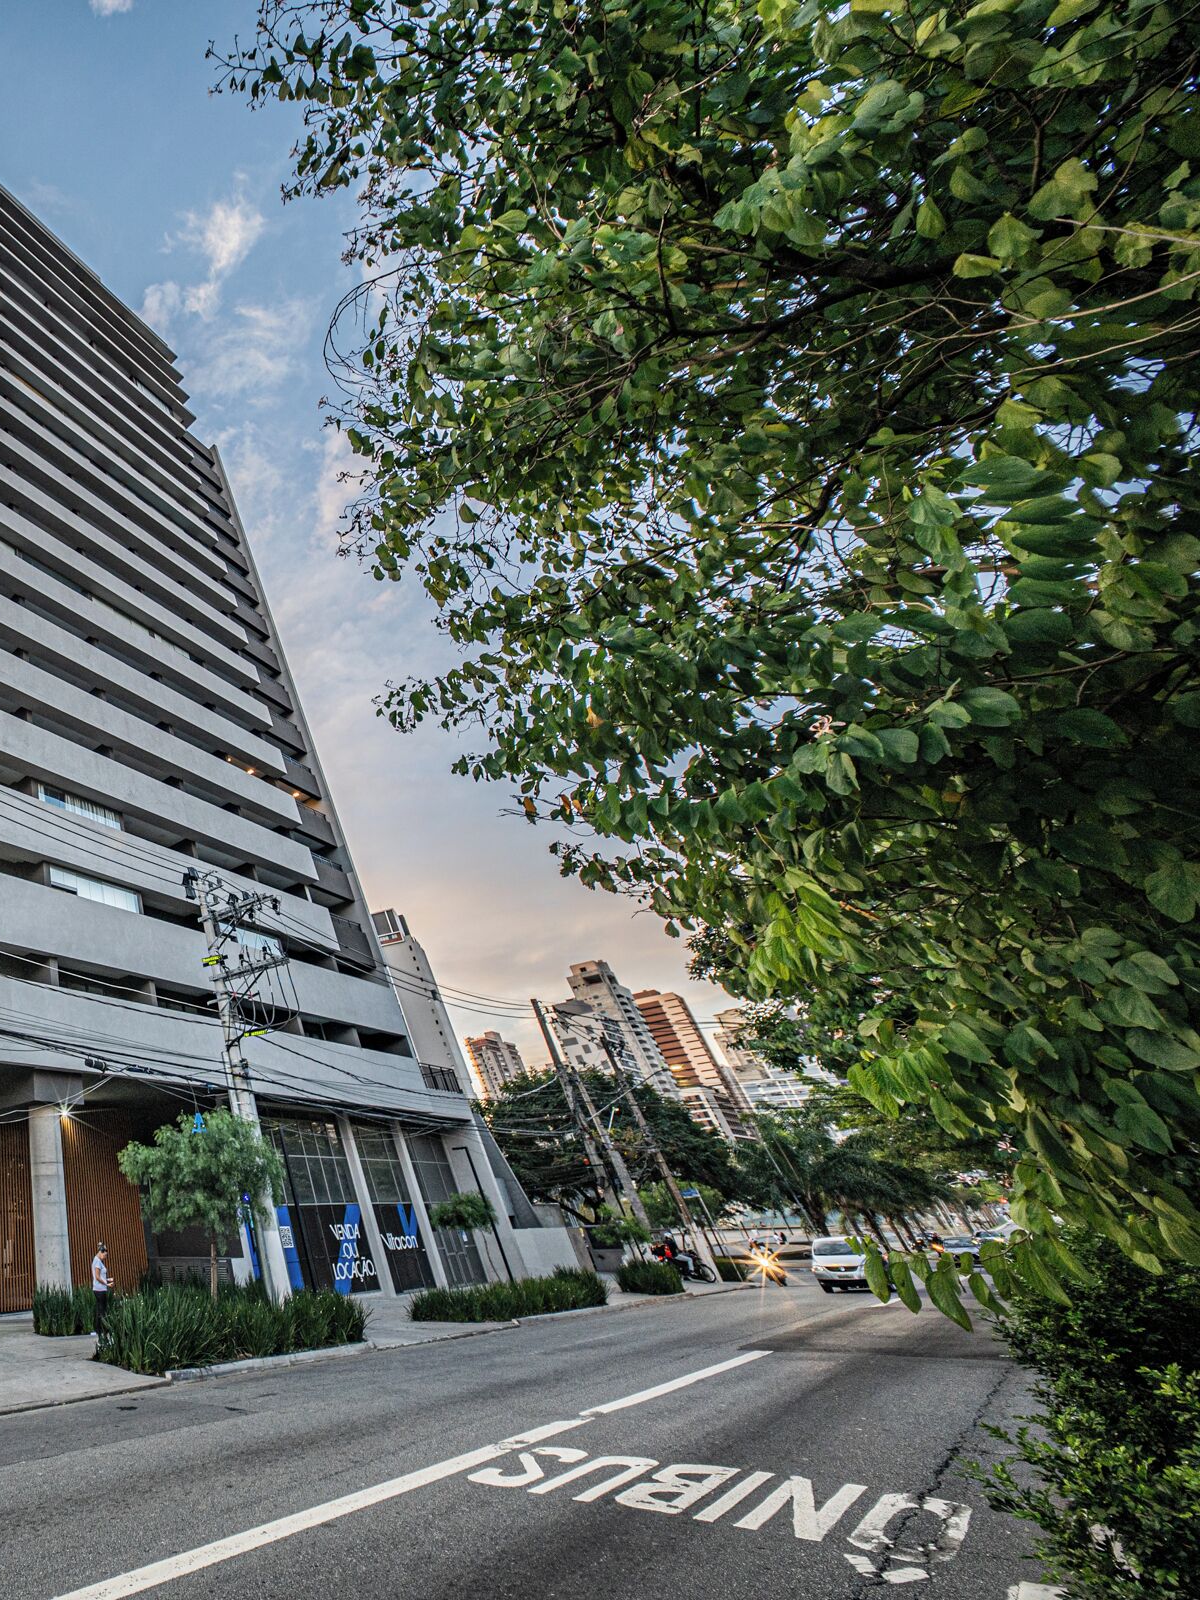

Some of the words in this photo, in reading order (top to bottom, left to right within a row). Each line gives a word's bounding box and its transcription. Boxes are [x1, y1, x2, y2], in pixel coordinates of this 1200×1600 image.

[329, 1223, 361, 1240] VENDA
[380, 1232, 419, 1250] Vitacon
[342, 1242, 360, 1259] OU
[332, 1256, 377, 1282] LOCAÇÃO.
